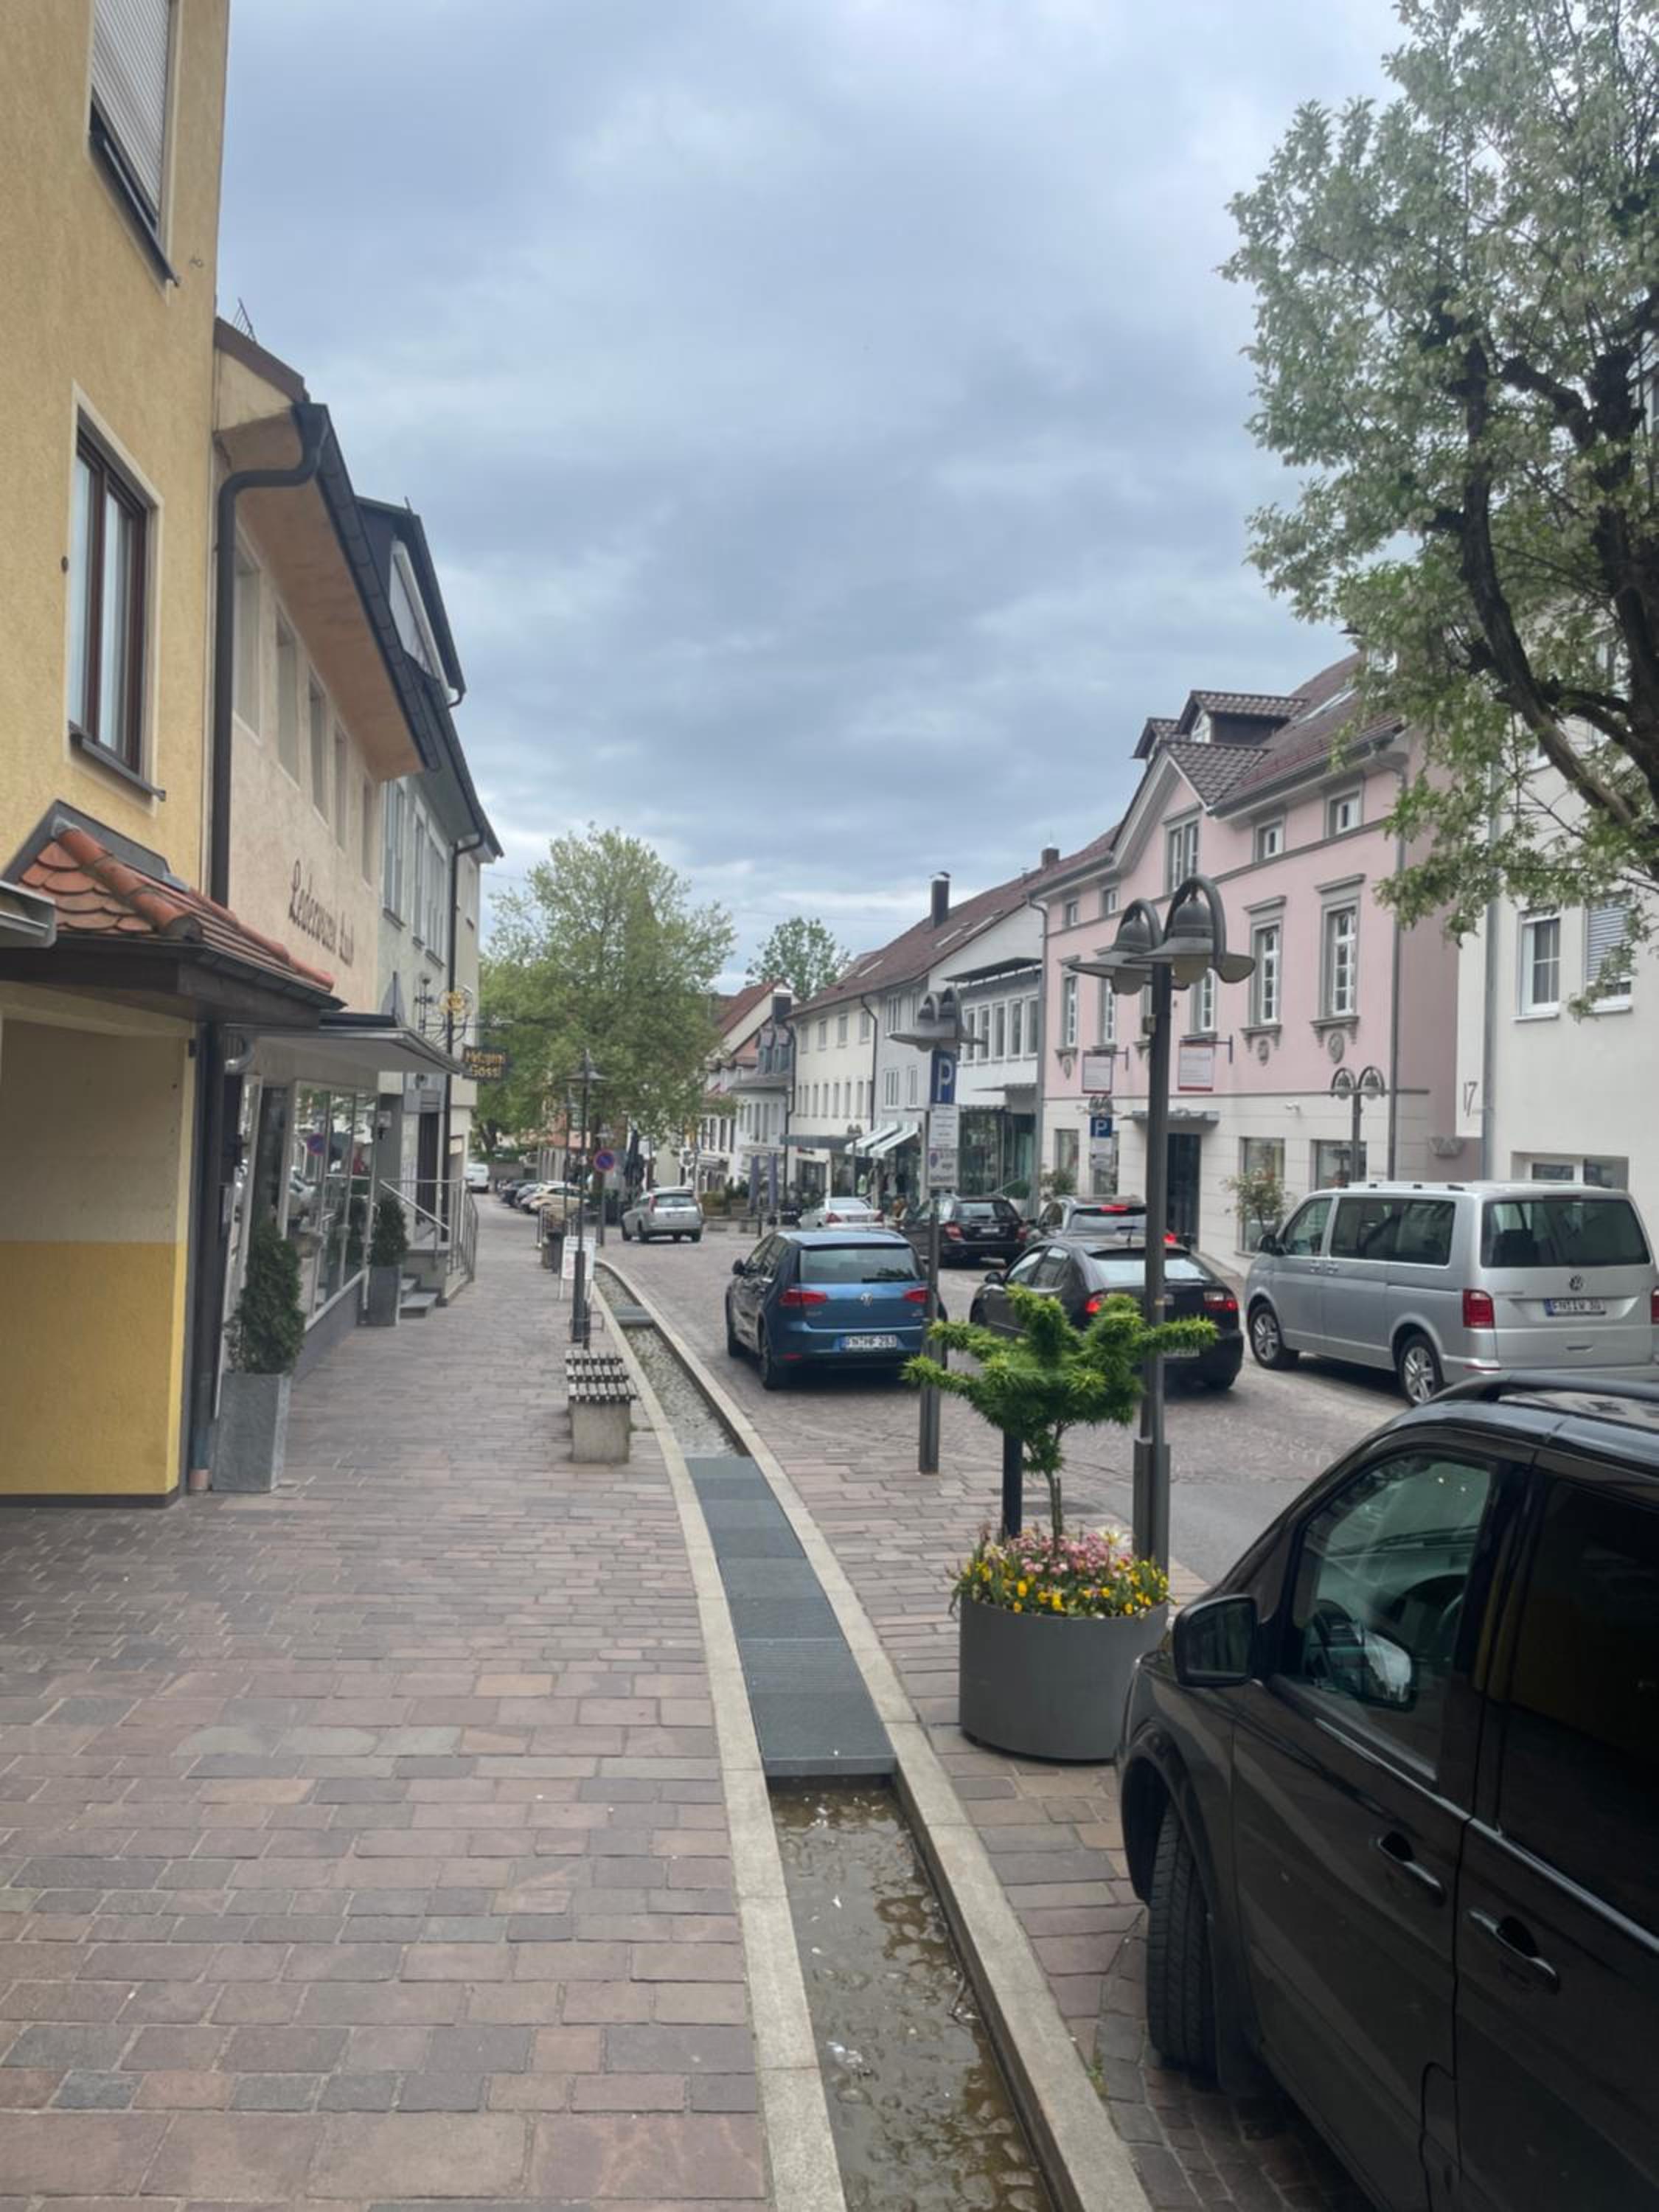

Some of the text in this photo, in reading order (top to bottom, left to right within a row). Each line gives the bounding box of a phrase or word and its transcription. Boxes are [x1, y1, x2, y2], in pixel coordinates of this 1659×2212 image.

[937, 1057, 953, 1101] P
[1464, 1081, 1478, 1117] 17
[1095, 1119, 1107, 1135] P
